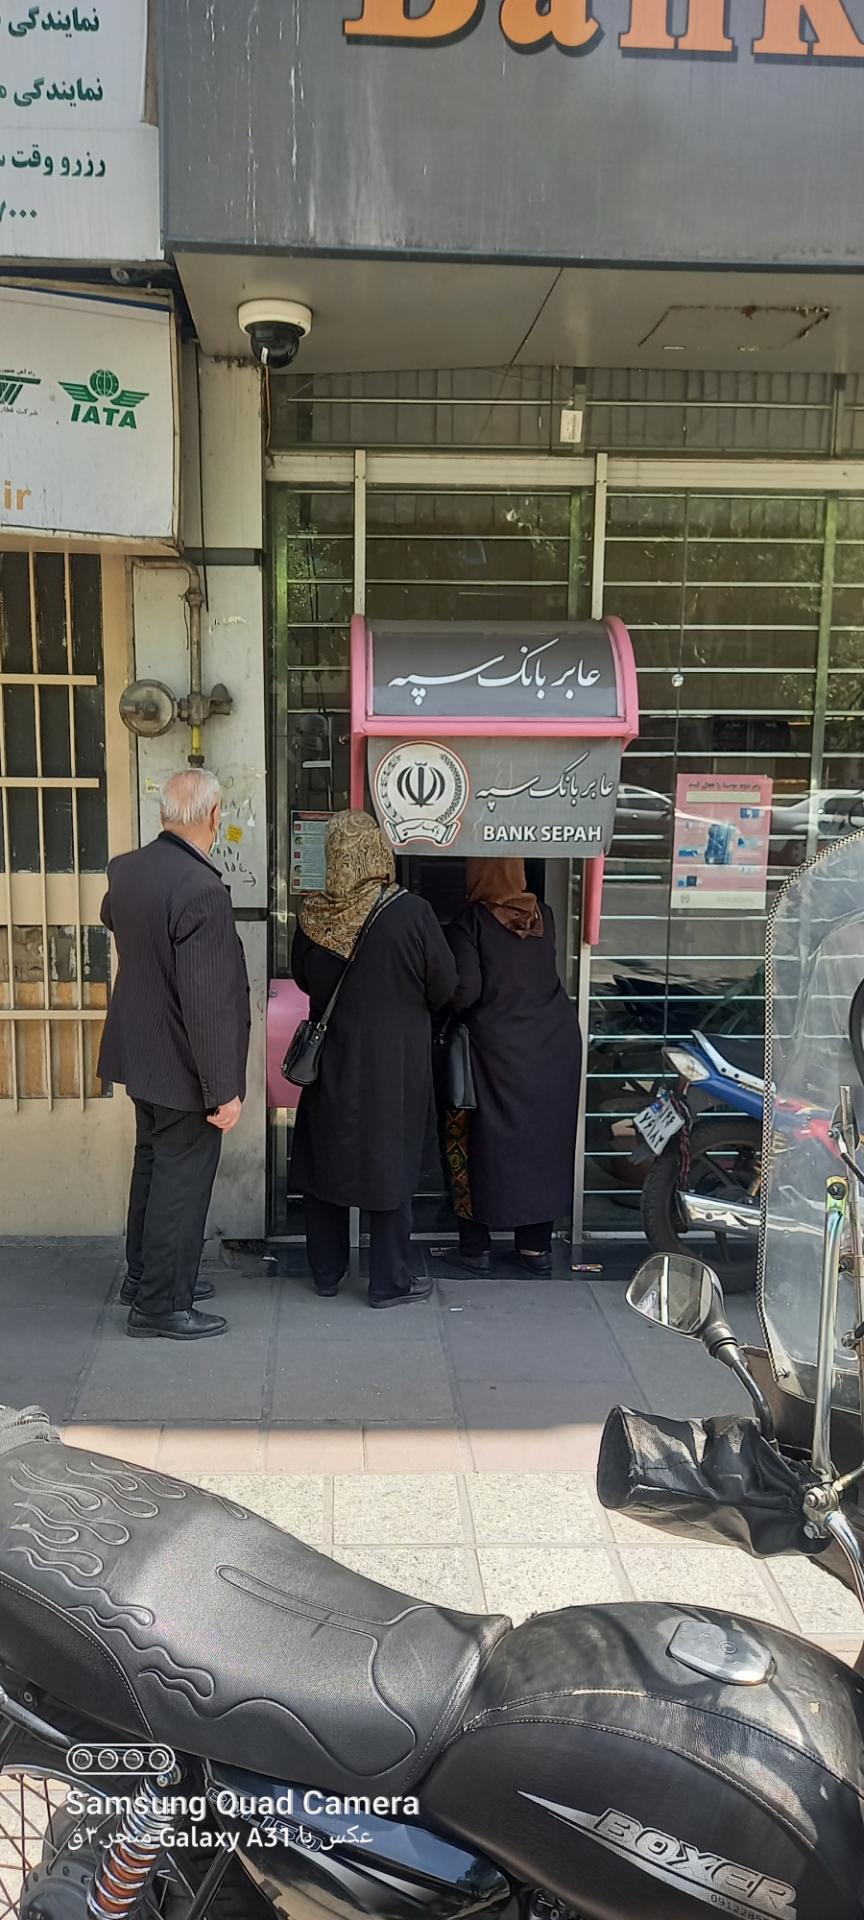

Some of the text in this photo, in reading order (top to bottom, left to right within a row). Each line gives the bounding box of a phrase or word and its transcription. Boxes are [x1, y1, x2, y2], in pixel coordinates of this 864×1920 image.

[8, 6, 100, 38] نمایندگی
[14, 77, 104, 107] نمایندگی
[12, 143, 54, 176] وقت
[60, 151, 106, 177] رزرو
[71, 404, 137, 429] IATA
[387, 638, 601, 706] عابر بانک سپه
[474, 749, 615, 812] عابر بانک سپه
[483, 823, 603, 843] BANK SEPAH
[595, 1807, 798, 1907] BOXER
